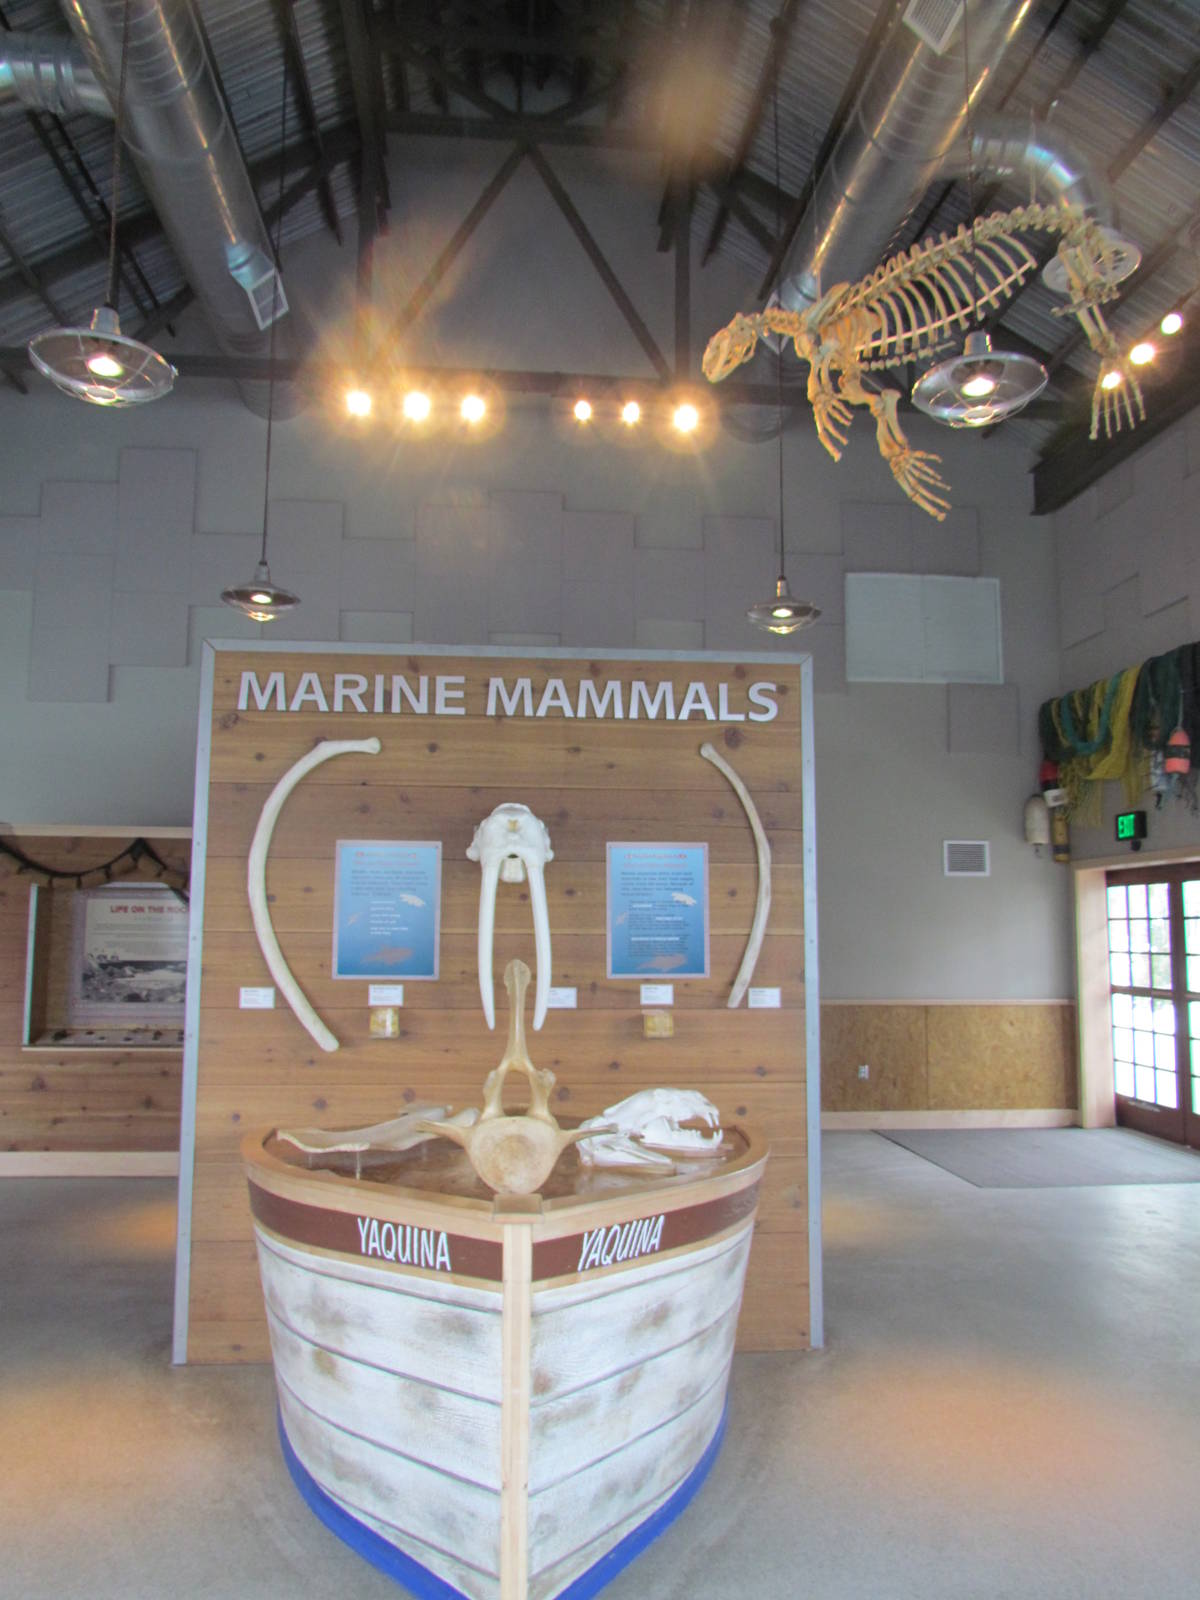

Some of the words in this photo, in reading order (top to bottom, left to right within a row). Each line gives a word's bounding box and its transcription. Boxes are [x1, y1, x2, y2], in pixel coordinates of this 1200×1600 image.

[237, 671, 466, 716] MARINE
[486, 677, 779, 722] MAMMALS
[110, 905, 129, 914] LIFE
[131, 905, 145, 914] ON
[148, 905, 164, 914] THE
[357, 1216, 452, 1272] YAQUINA
[576, 1213, 666, 1273] YAQUINA
